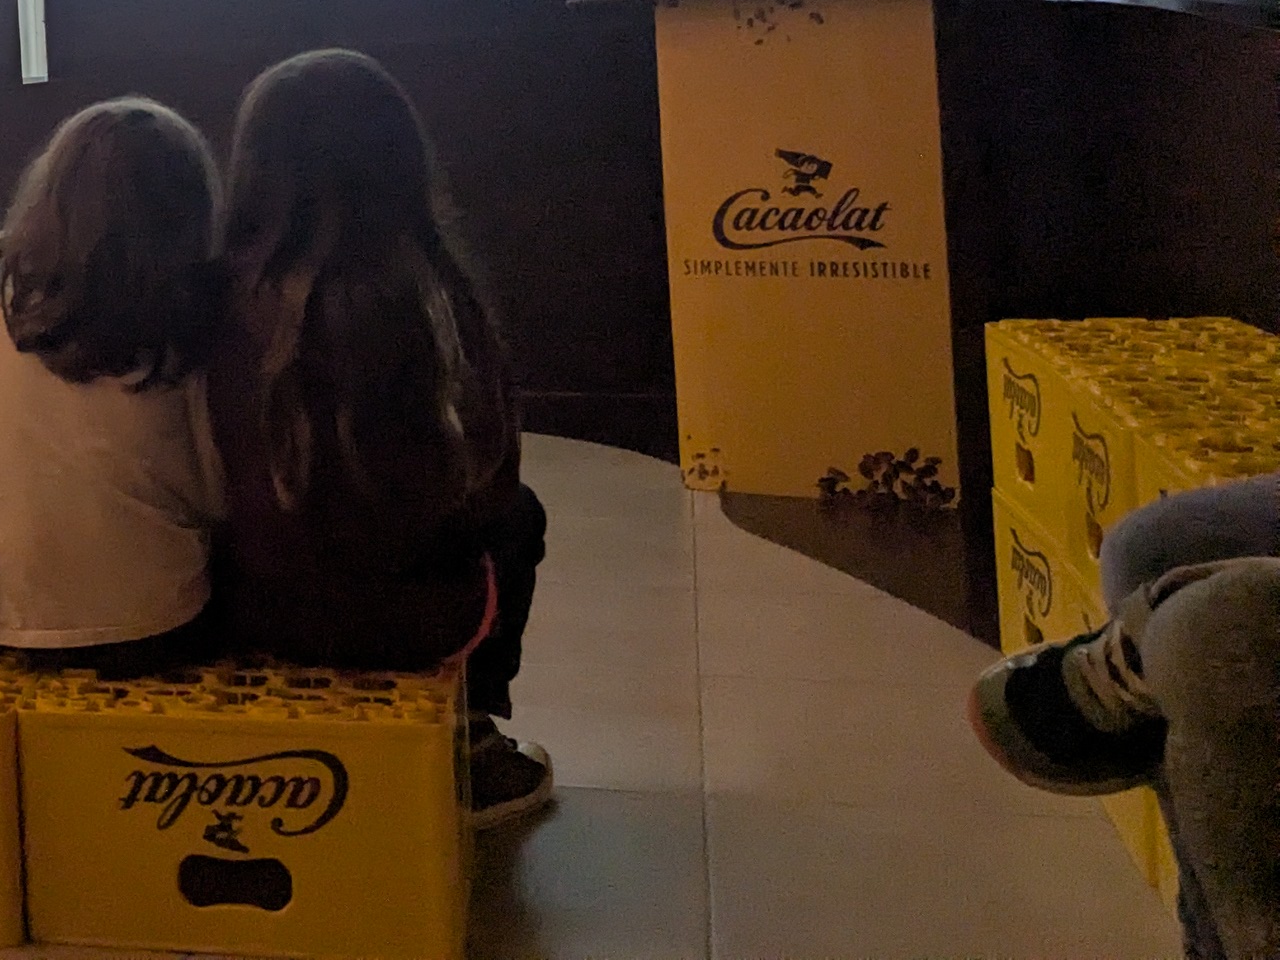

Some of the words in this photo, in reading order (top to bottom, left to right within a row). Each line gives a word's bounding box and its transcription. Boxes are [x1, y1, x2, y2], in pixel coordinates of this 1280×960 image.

[712, 188, 892, 251] Cacaolat
[683, 259, 800, 278] SIMPLEMENTE
[809, 260, 932, 280] IRRESISTIBLE
[119, 744, 349, 837] Cacaolat
